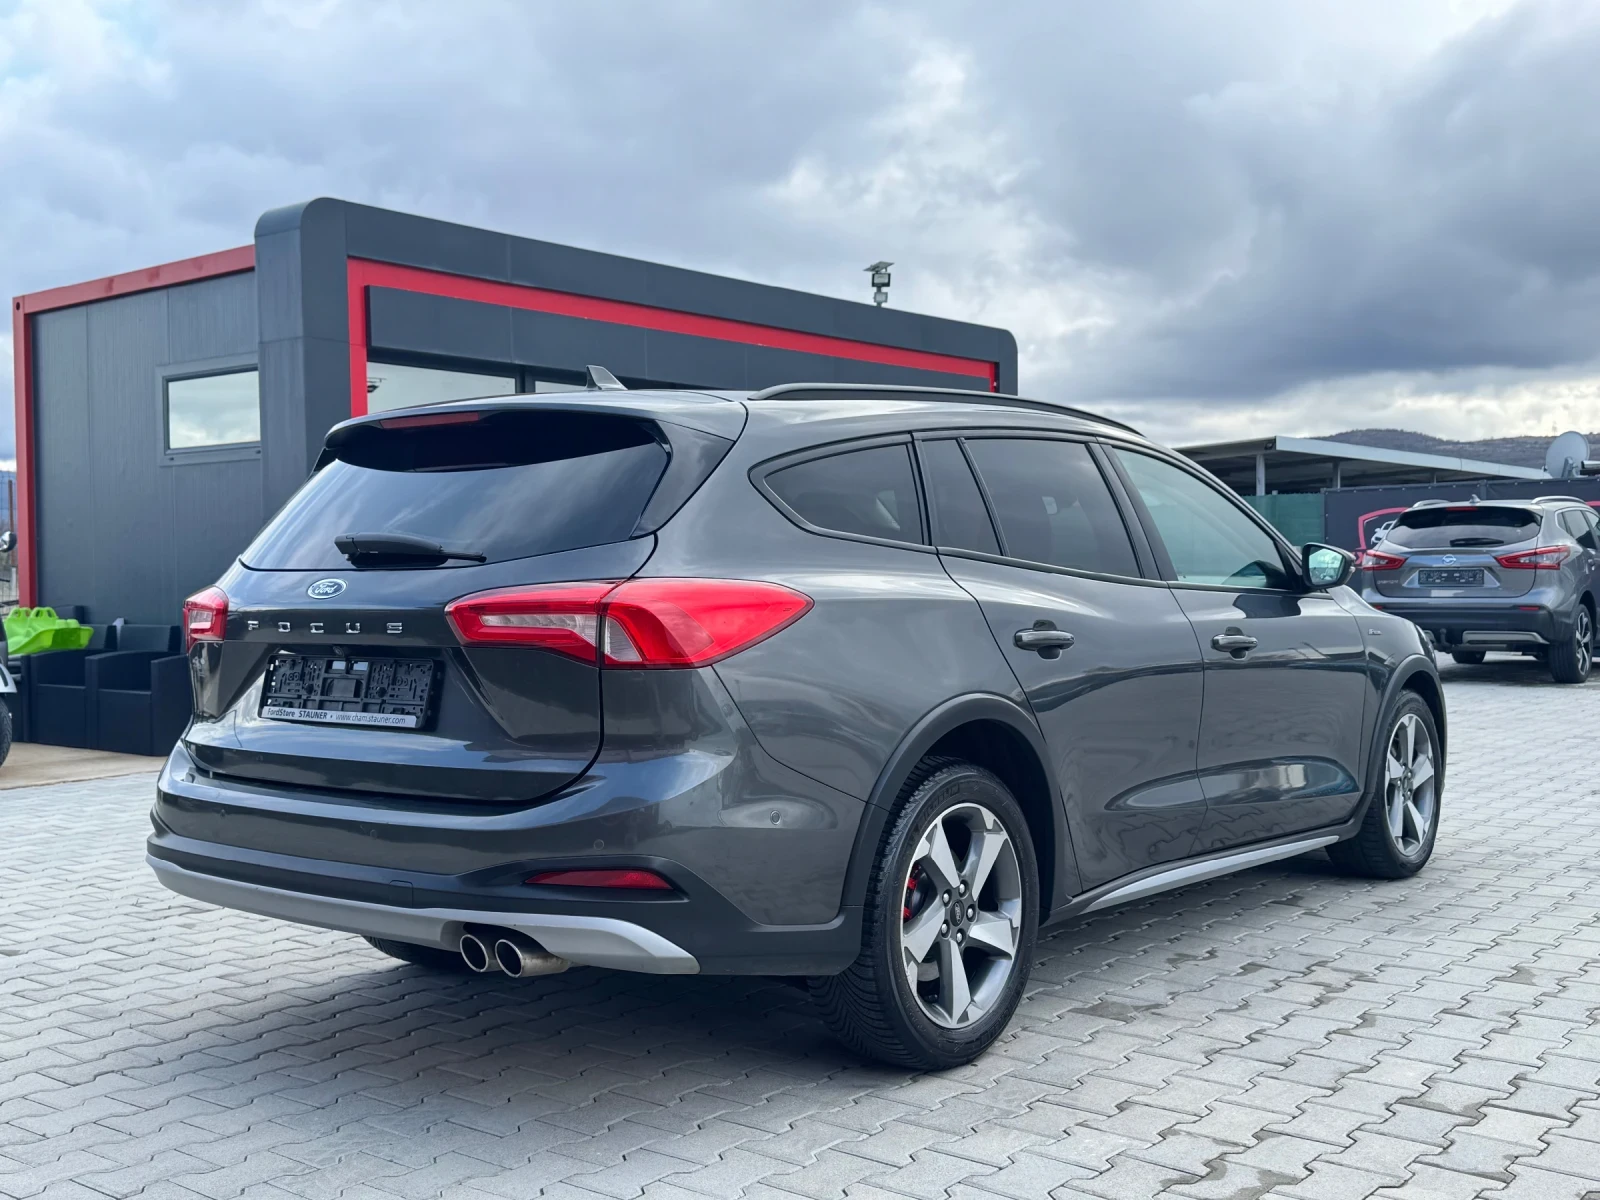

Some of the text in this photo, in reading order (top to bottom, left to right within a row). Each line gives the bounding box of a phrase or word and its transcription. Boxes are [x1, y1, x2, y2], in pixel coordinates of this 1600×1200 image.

[247, 620, 403, 634] FOCUS
[267, 707, 296, 718] FordStore
[298, 710, 328, 720] STAUNER
